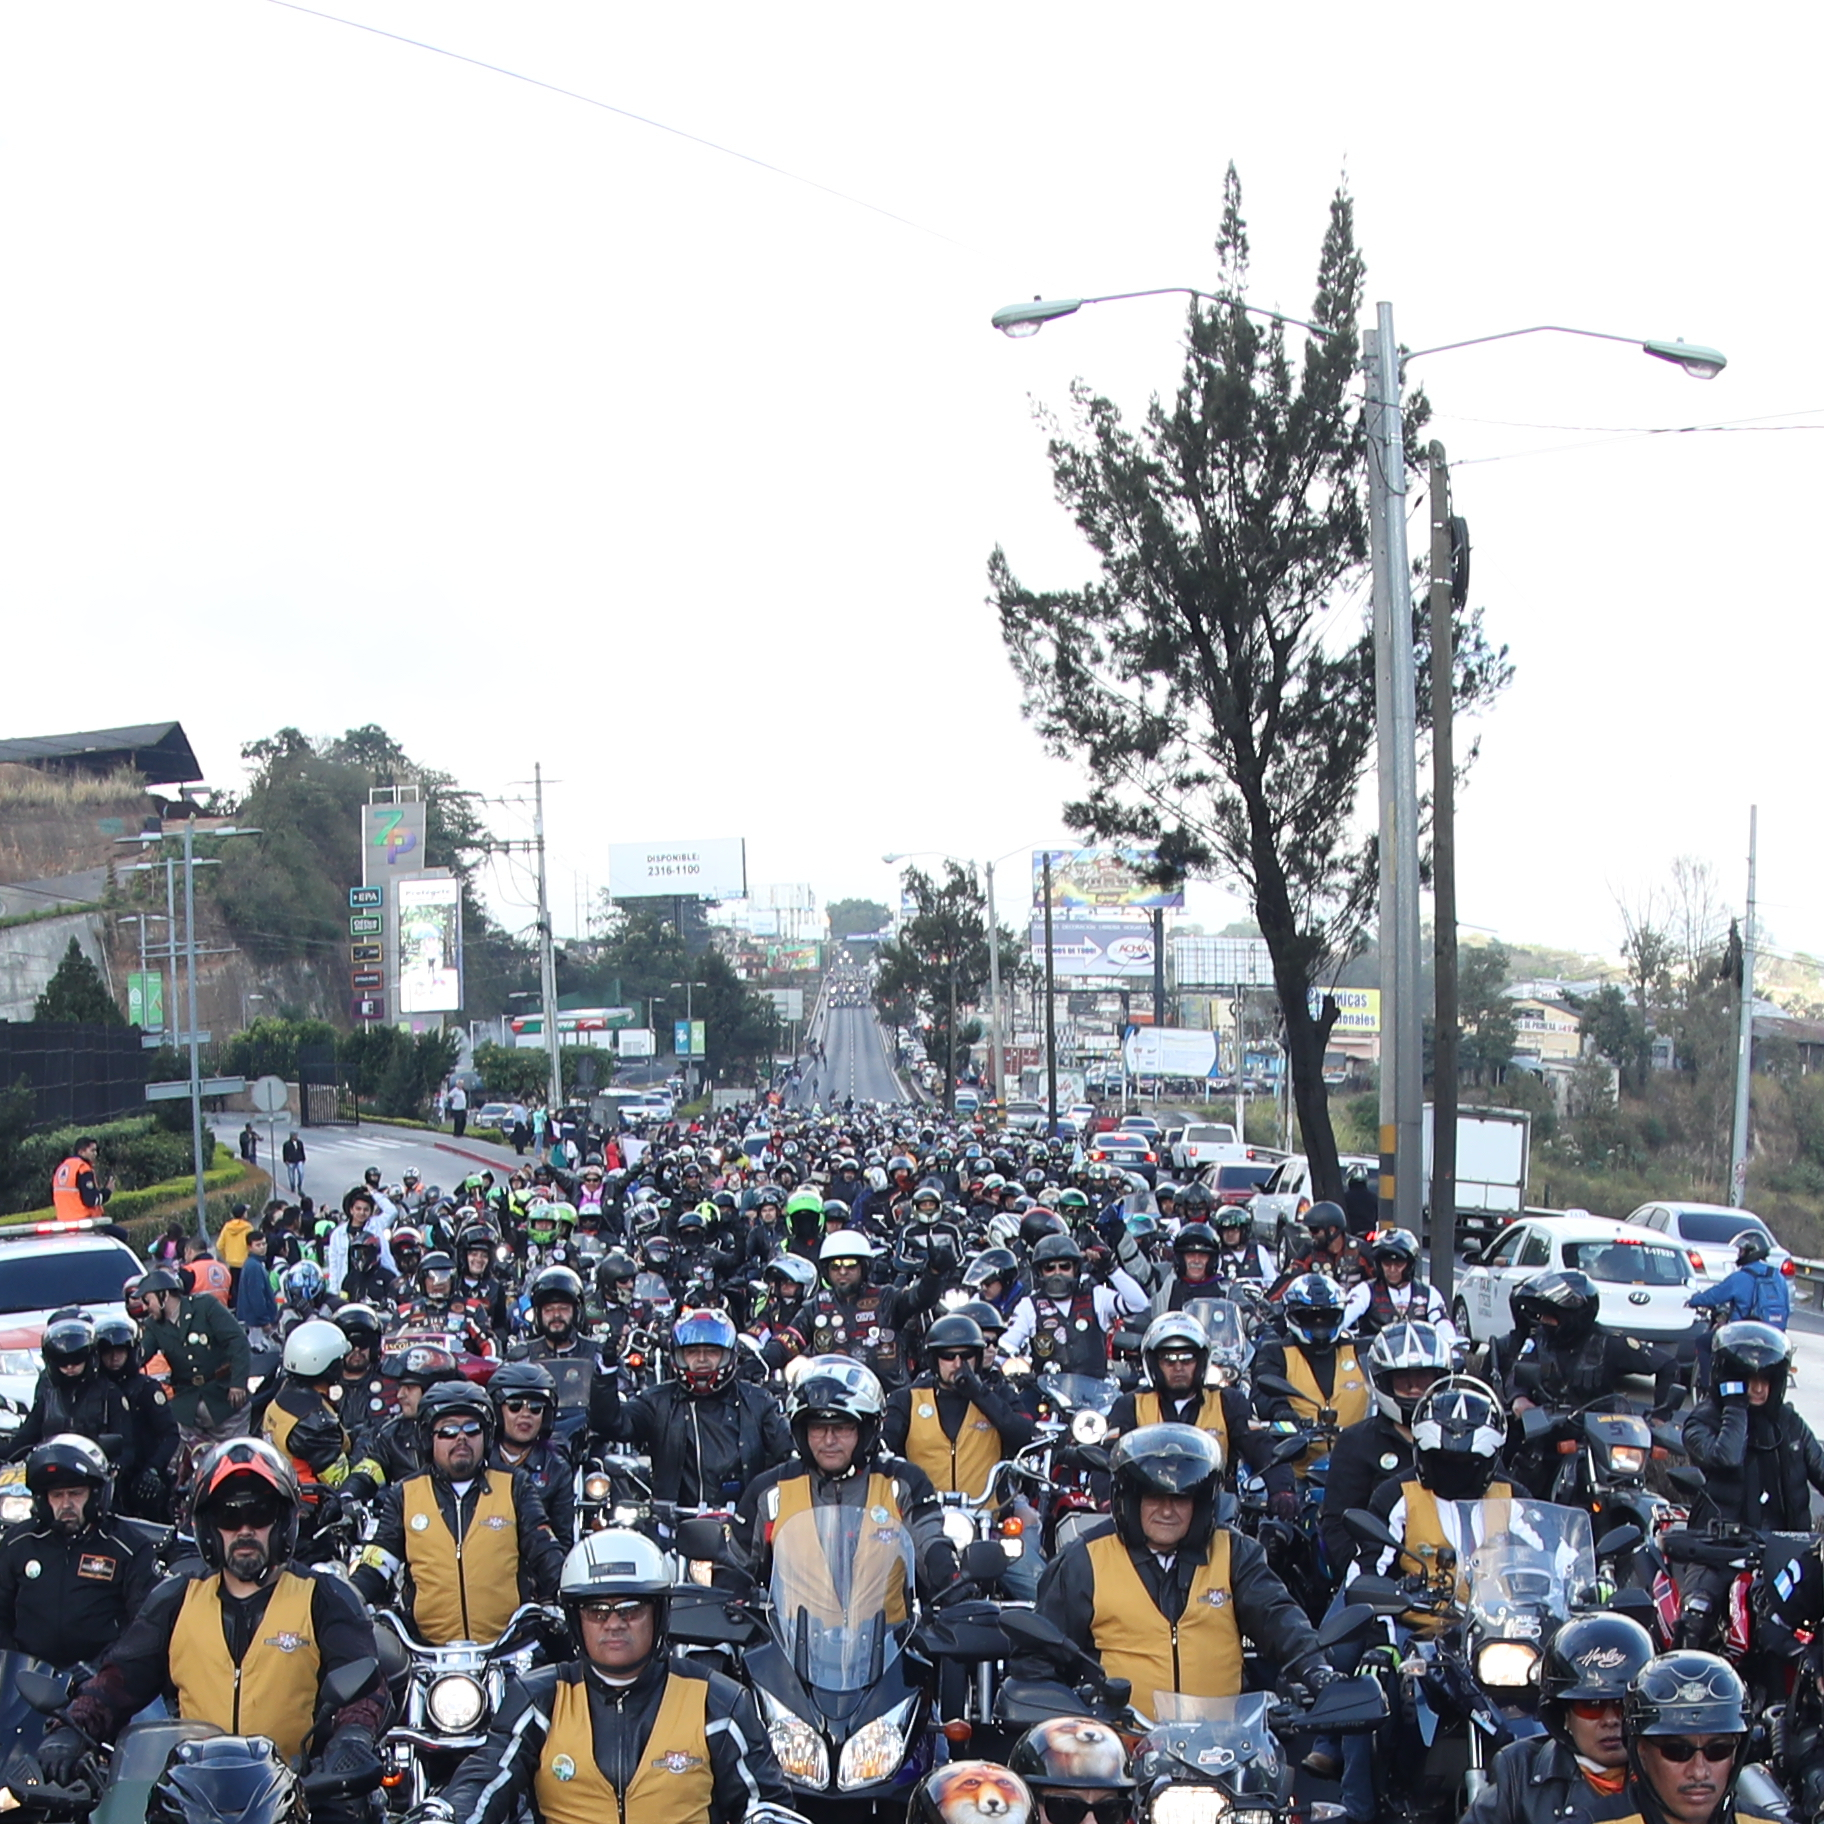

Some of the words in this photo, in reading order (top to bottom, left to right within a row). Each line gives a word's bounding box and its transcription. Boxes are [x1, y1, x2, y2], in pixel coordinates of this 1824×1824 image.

[648, 864, 700, 876] 2316-1100
[358, 892, 378, 902] EPA
[1576, 1646, 1627, 1669] Harley
